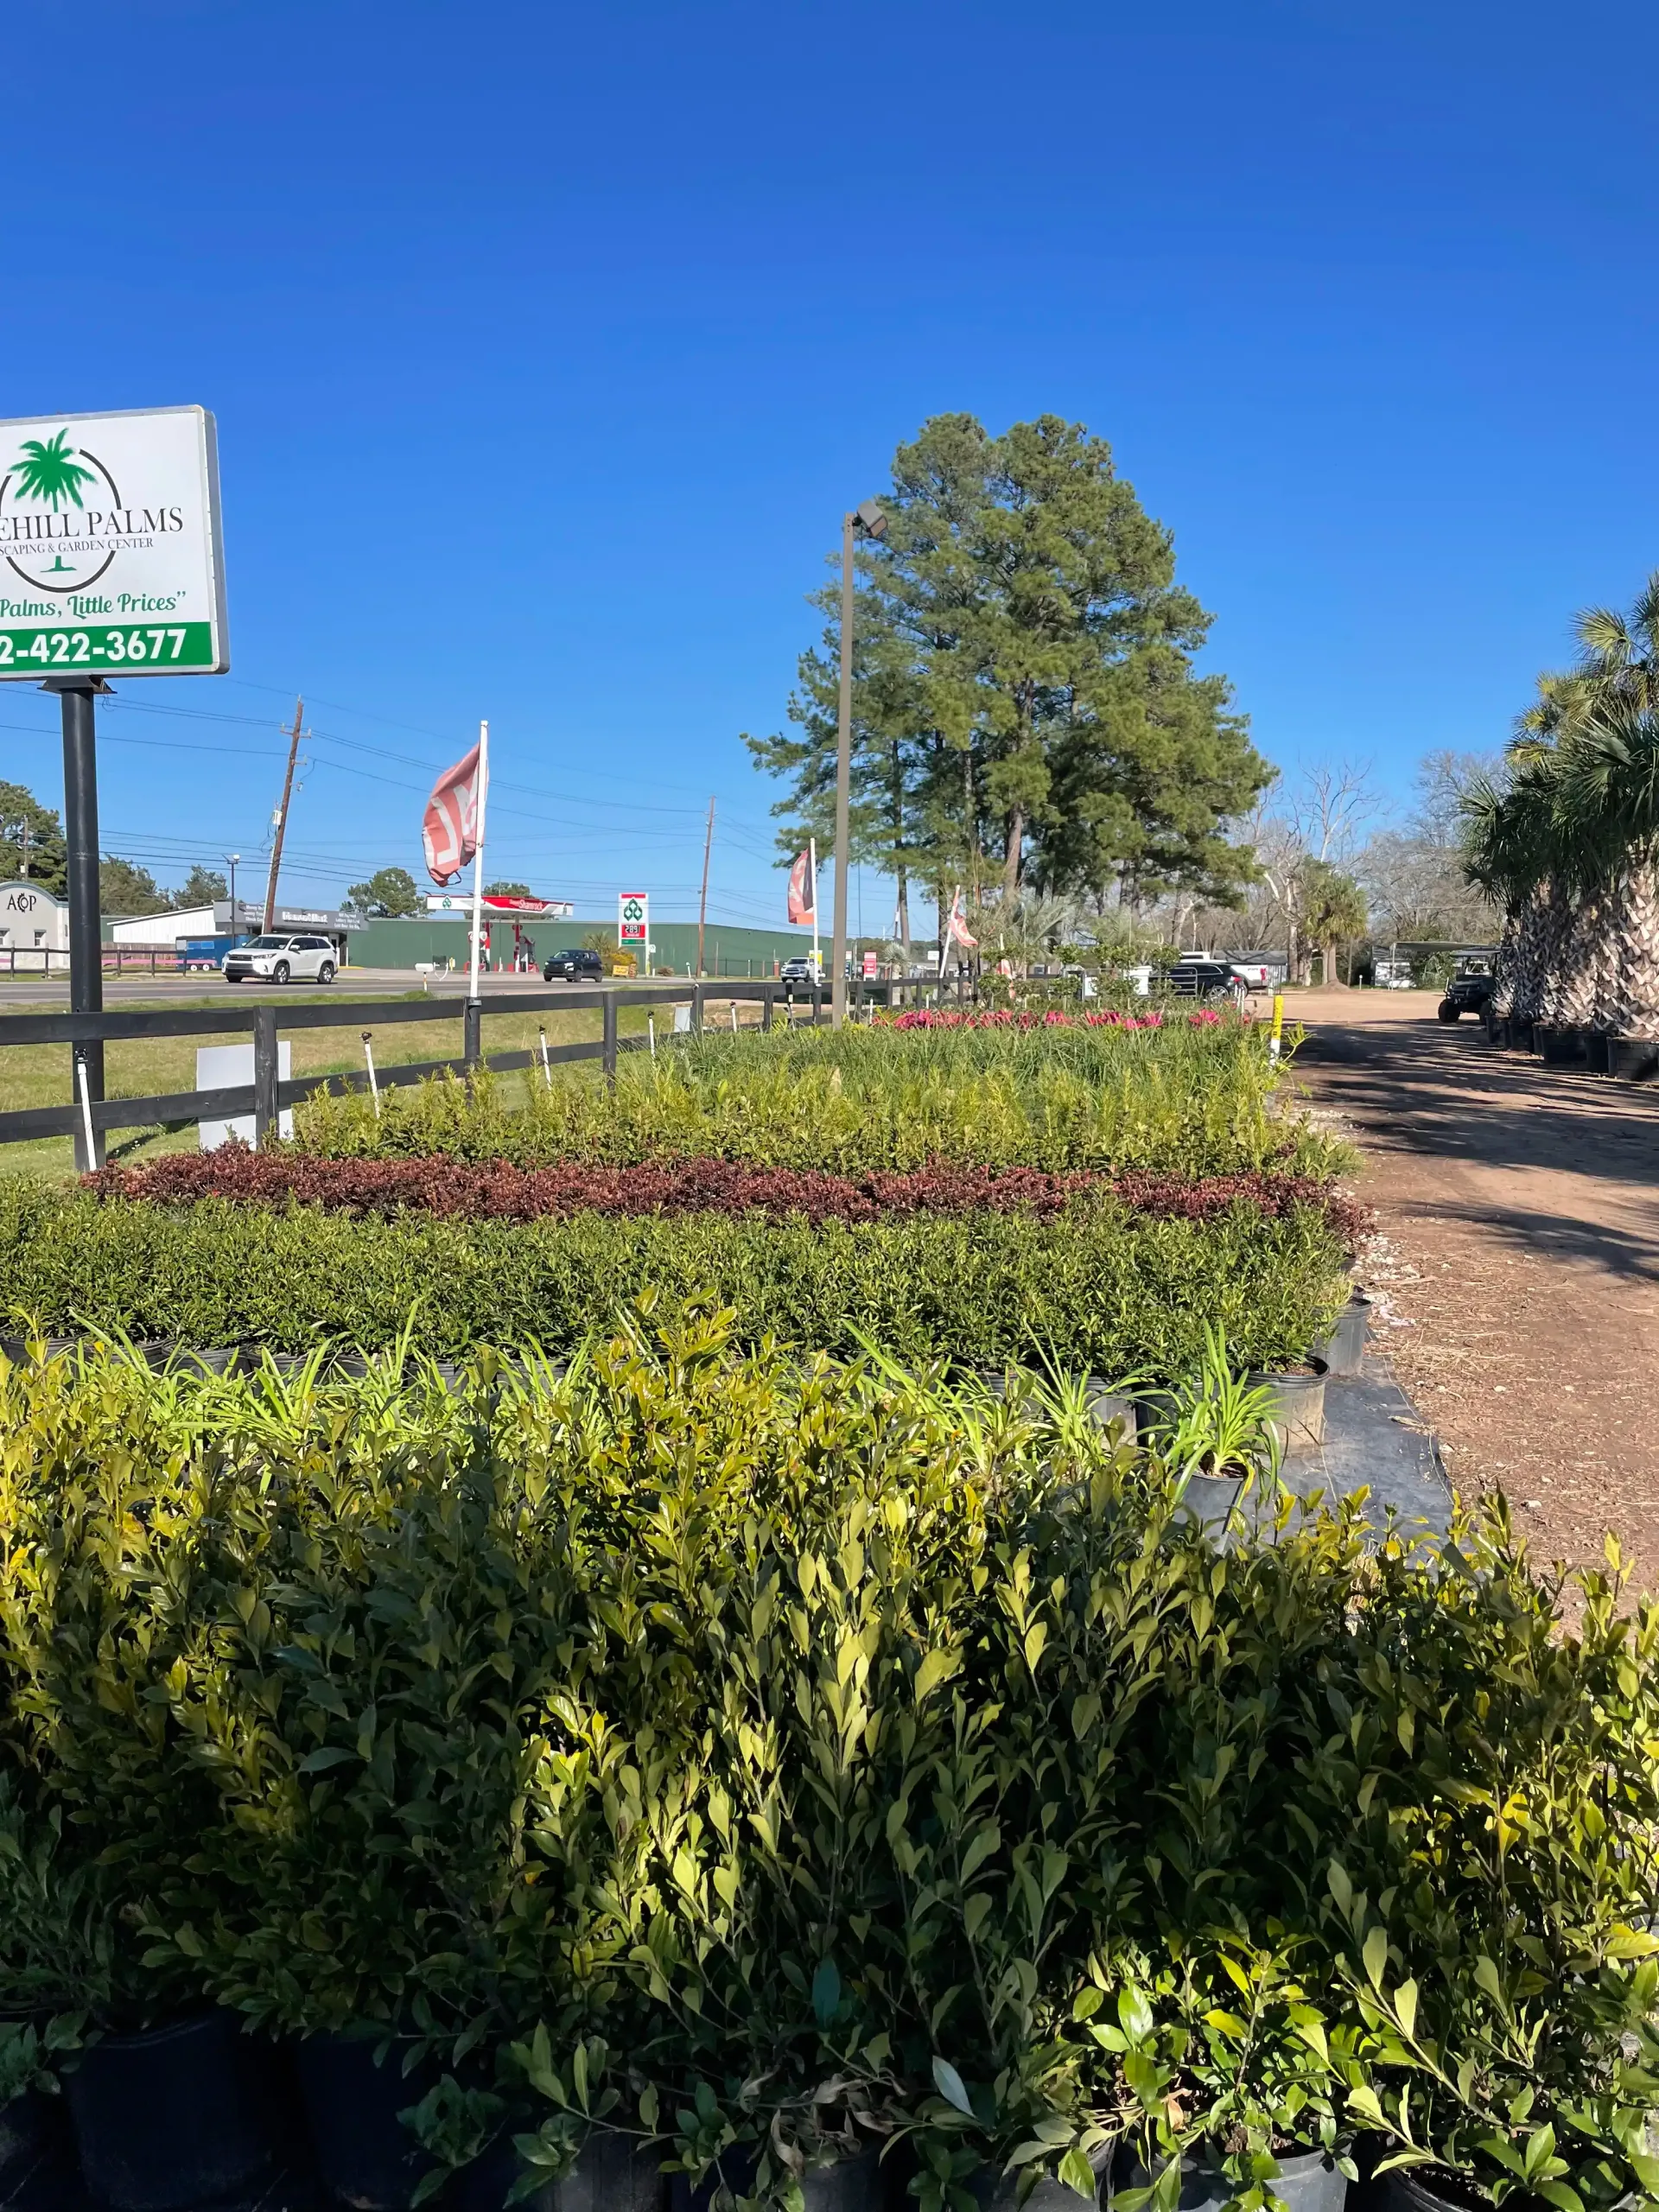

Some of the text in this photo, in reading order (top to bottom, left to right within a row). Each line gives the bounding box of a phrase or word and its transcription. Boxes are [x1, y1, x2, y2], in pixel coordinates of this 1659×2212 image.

[86, 506, 183, 536] PALMS
[48, 542, 56, 553] &
[58, 540, 104, 552] GARDEN
[107, 537, 153, 550] CENTER
[0, 591, 186, 620] Palms, Little Prices"
[0, 629, 187, 664] 2-422-3677
